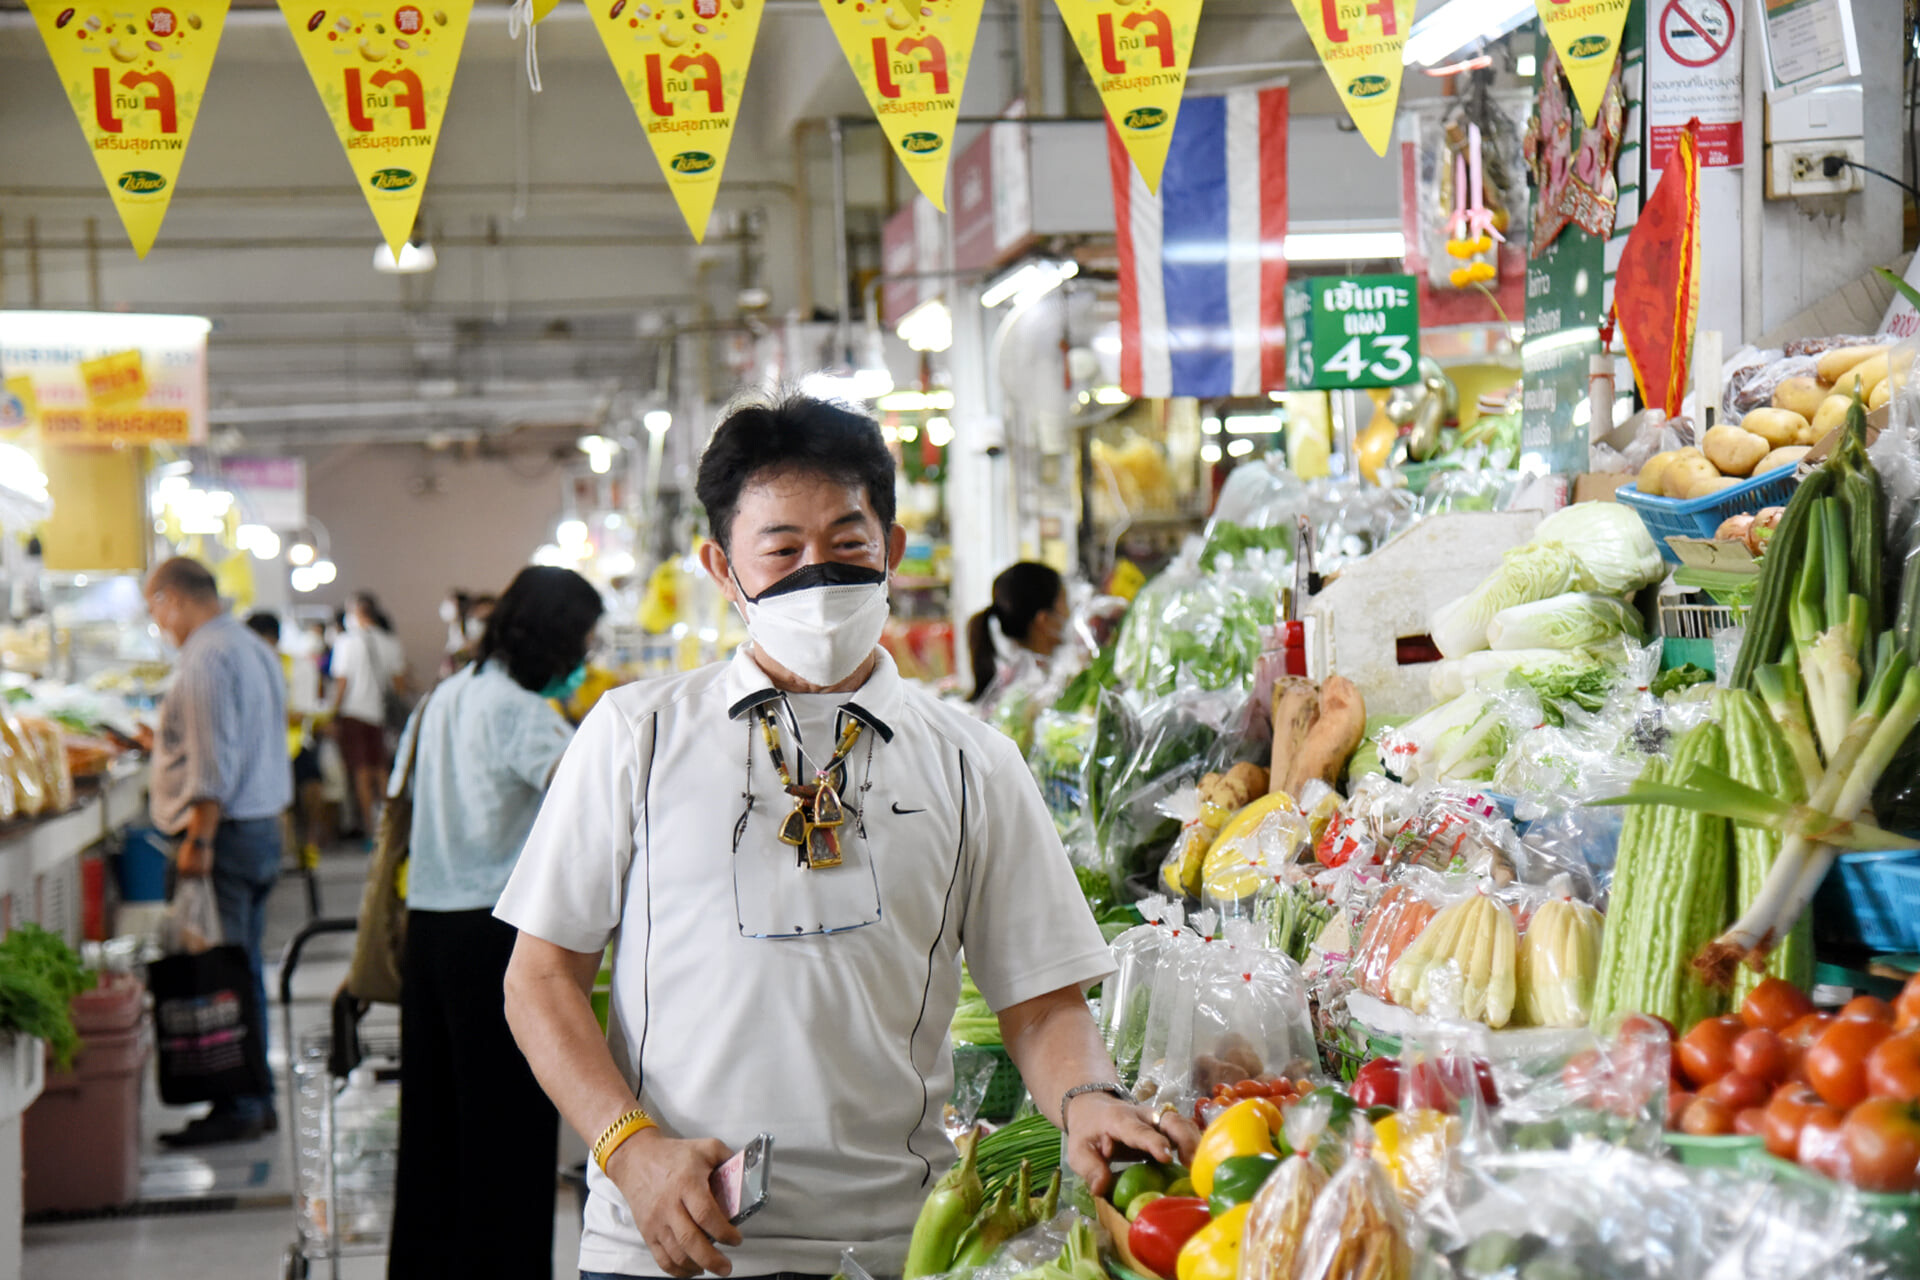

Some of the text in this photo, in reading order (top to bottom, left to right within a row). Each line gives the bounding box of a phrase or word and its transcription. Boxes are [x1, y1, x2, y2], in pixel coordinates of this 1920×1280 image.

[1341, 5, 1361, 20] กิน
[1545, 0, 1625, 23] เสริมสุขภาพ
[1097, 9, 1175, 74] เจ
[1119, 36, 1139, 50] กิน
[1325, 37, 1403, 62] เสริมสุขภาพ
[872, 35, 949, 98] เจ
[893, 61, 913, 74] กิน
[645, 53, 724, 116] เจ
[667, 79, 688, 92] กิน
[1101, 72, 1181, 93] เสริมสุขภาพ
[94, 68, 177, 133] เจ
[116, 95, 138, 109] กิน
[344, 68, 426, 132] เจ
[366, 94, 388, 108] กิน
[878, 99, 955, 117] เสริมสุขภาพ
[648, 118, 730, 136] เสริมสุขภาพ
[95, 136, 182, 154] เสริมสุขภาพ
[347, 135, 431, 152] เสริมสุขภาพ
[1322, 335, 1412, 382] 43
